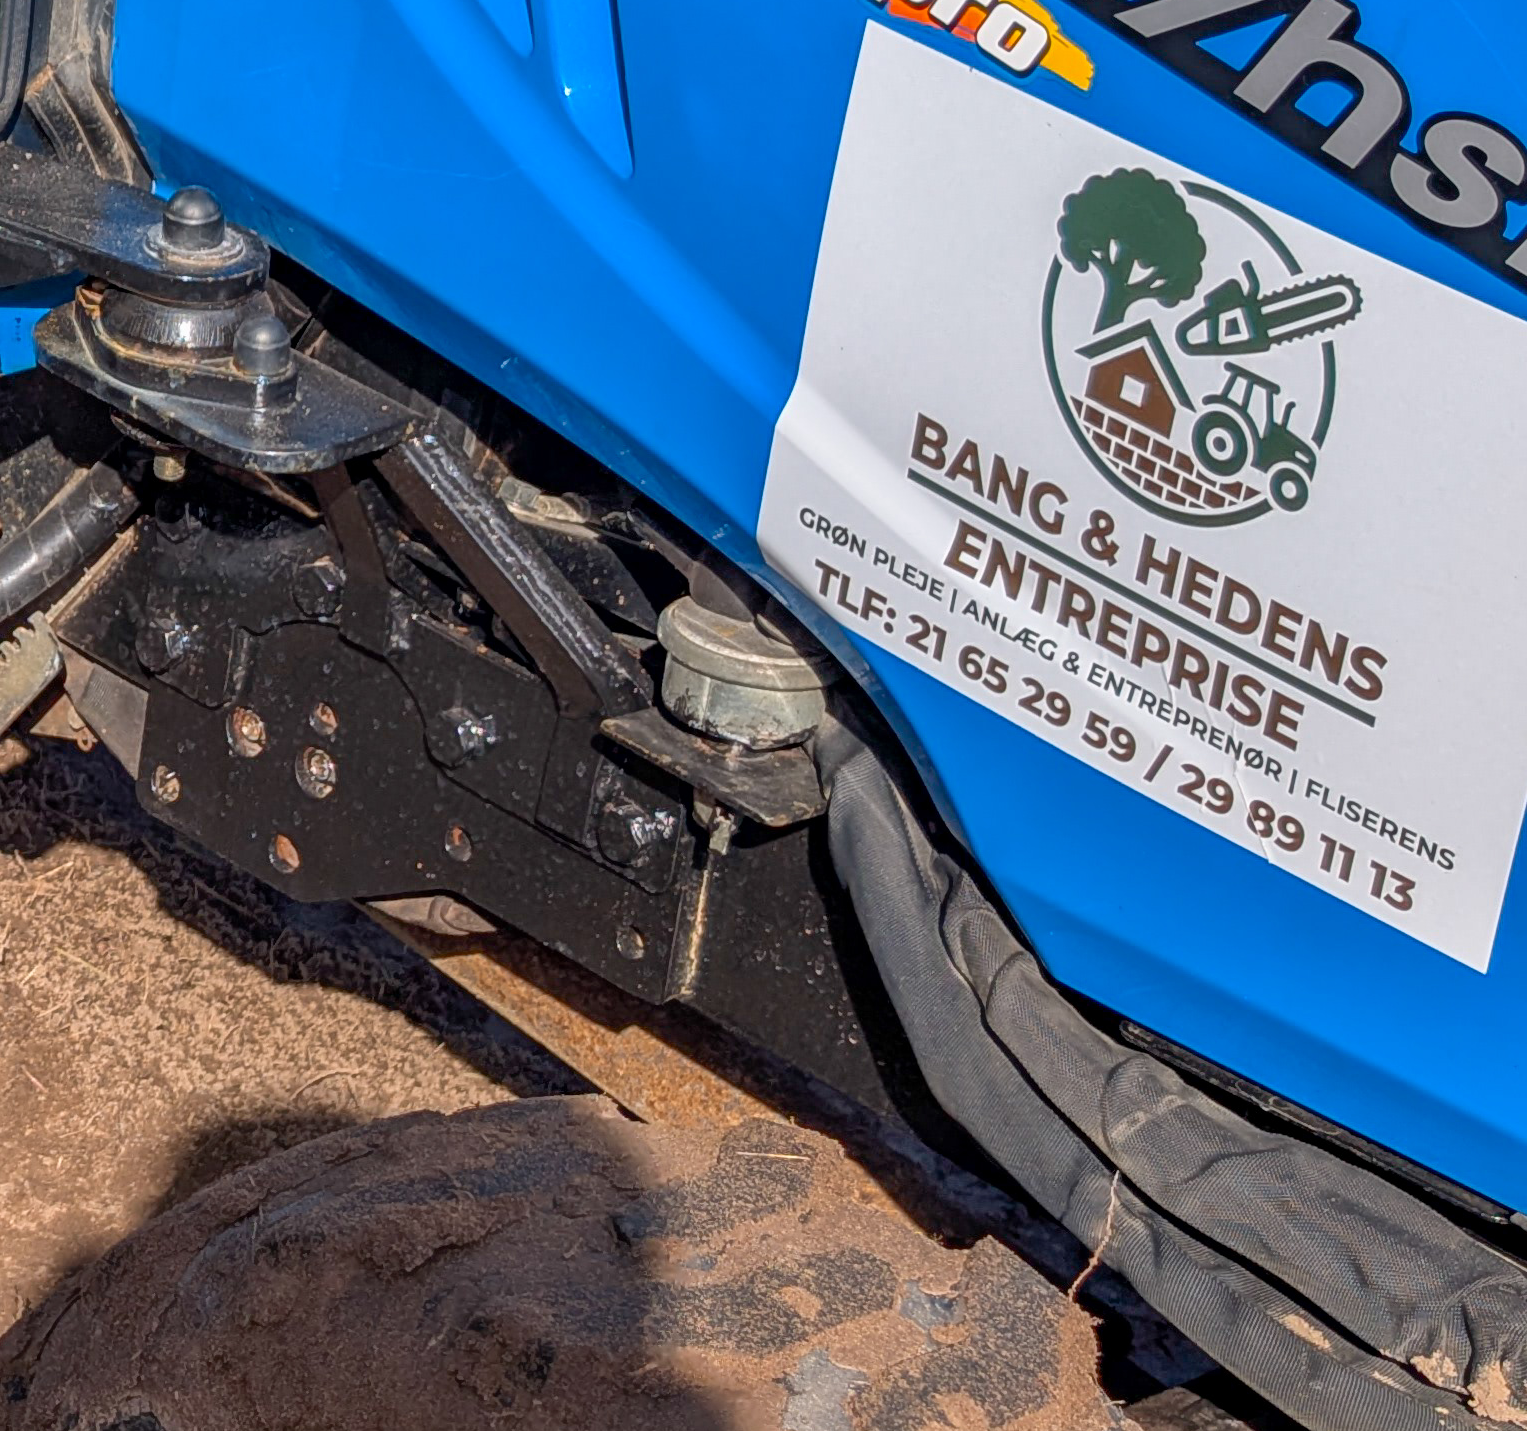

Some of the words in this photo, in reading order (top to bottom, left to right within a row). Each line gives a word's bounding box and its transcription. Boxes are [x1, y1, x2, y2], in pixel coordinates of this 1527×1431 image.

[799, 507, 867, 558] GRØN
[873, 547, 945, 602] PLEJE
[962, 599, 1058, 661] ANLÆG
[1062, 651, 1080, 675] &
[1087, 662, 1283, 782] ENTREPRENØR
[1304, 778, 1456, 871] FLISERENS
[910, 411, 1069, 536] BANG
[1080, 509, 1120, 567] &
[1134, 532, 1388, 702] HEDENS
[943, 518, 1305, 752] ENTREPRISE
[814, 558, 897, 634] TLF:
[905, 614, 948, 663] 21
[957, 645, 1009, 694] 65
[1018, 676, 1072, 727] 29
[1081, 710, 1137, 763] 59
[1176, 763, 1235, 815] 29
[1246, 799, 1305, 852] 89
[1318, 832, 1356, 883] 11
[1369, 859, 1417, 912] 13
